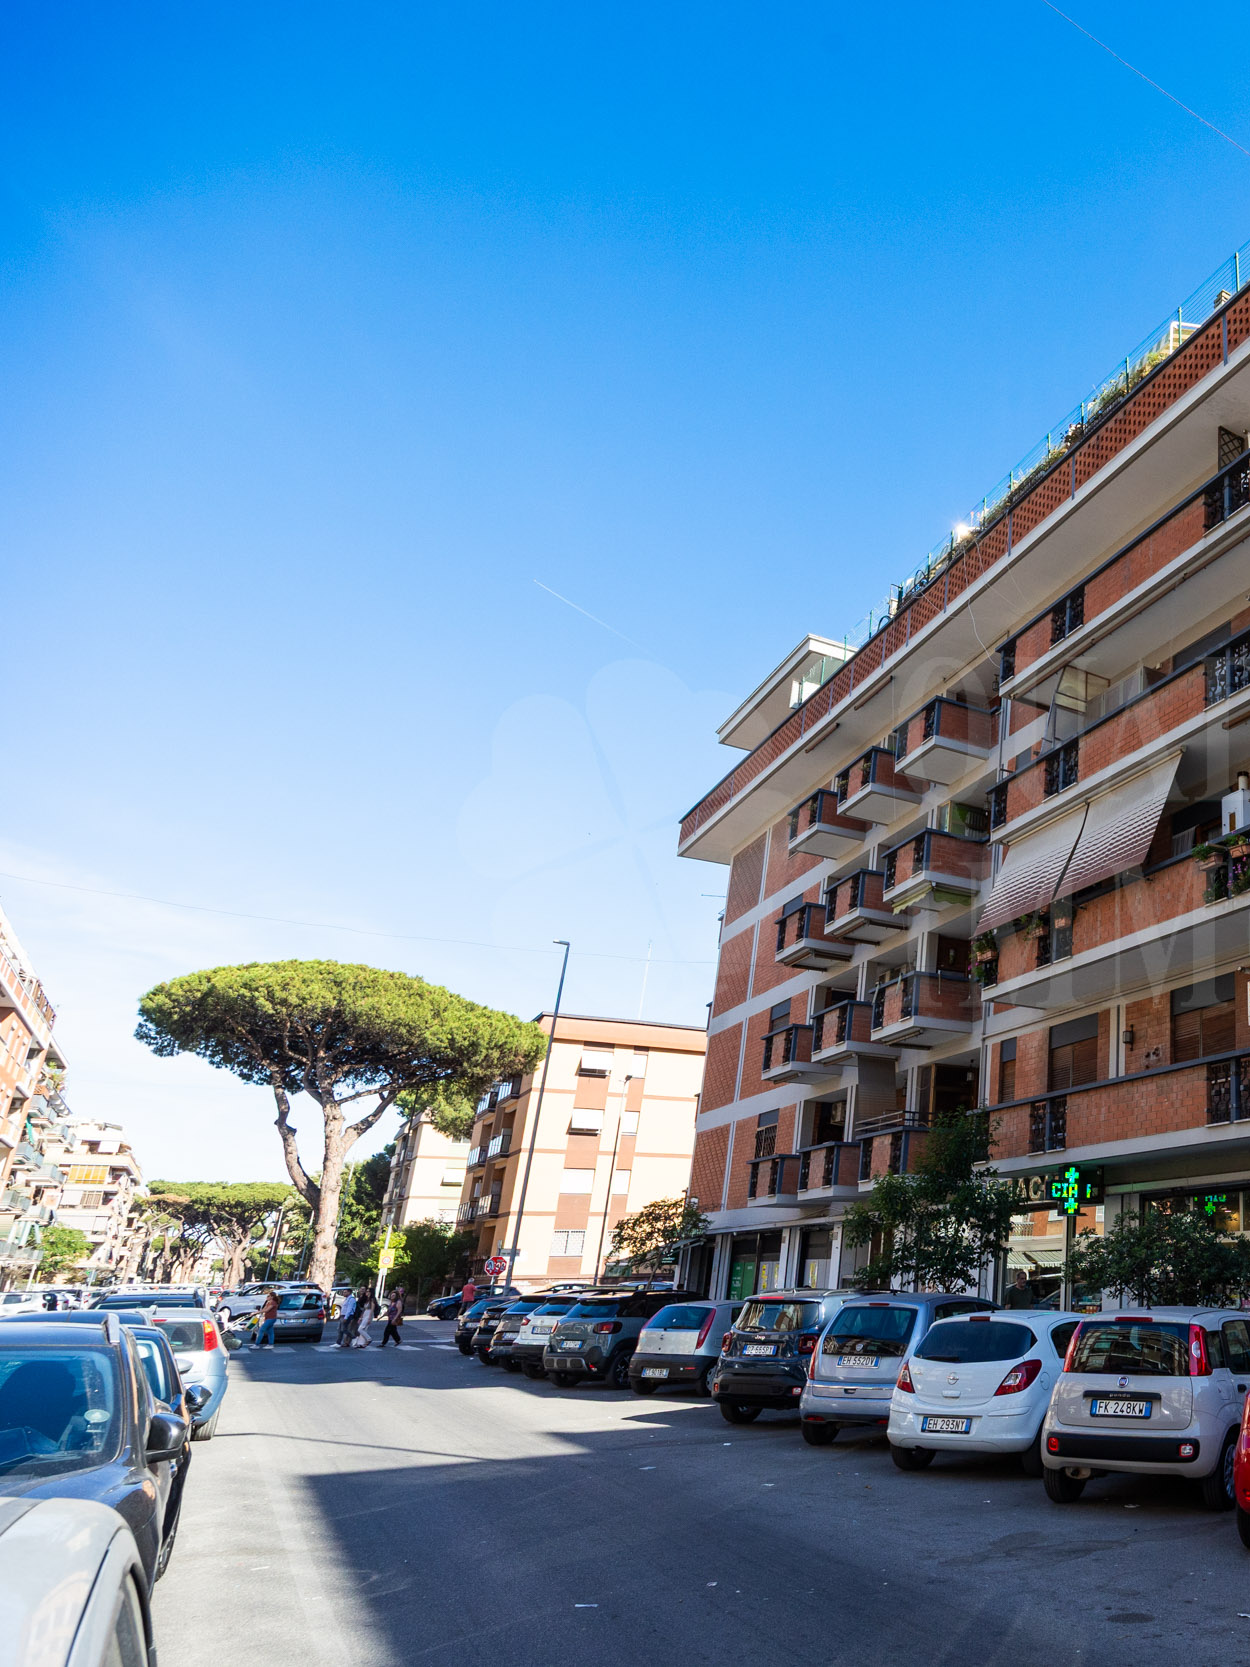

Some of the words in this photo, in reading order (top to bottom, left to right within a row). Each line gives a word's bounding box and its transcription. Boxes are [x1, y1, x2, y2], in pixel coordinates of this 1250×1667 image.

[841, 1355, 852, 1365] EH
[852, 1356, 876, 1366] 552DV
[1097, 1401, 1110, 1414] FK
[1113, 1401, 1145, 1416] 248KW
[927, 1417, 939, 1430] EH
[940, 1418, 966, 1432] 293NY
